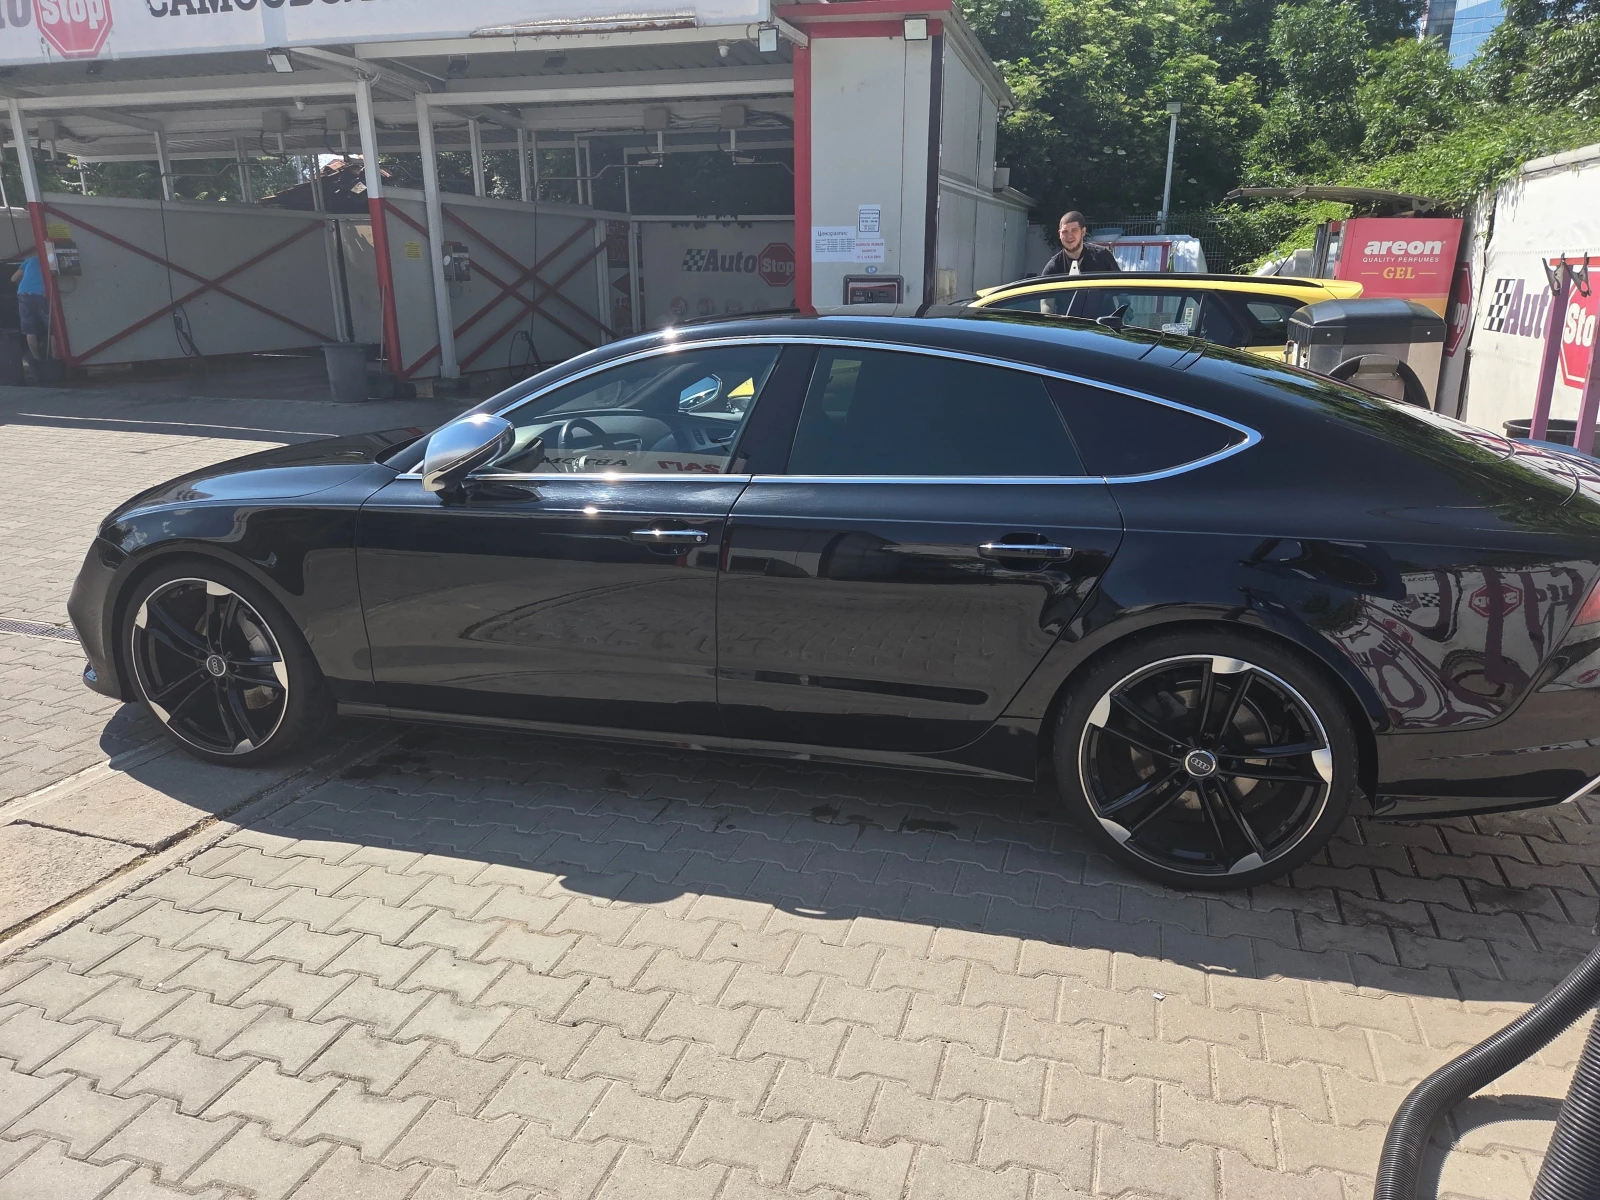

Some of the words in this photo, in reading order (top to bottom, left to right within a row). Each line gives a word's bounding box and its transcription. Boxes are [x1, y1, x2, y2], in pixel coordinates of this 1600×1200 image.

[1364, 240, 1442, 255] areon
[702, 249, 758, 273] Auto
[762, 258, 795, 276] Stop
[1383, 267, 1416, 279] GEL
[1453, 302, 1469, 334] op
[1502, 279, 1552, 340] Aut
[1563, 302, 1596, 347] Sto
